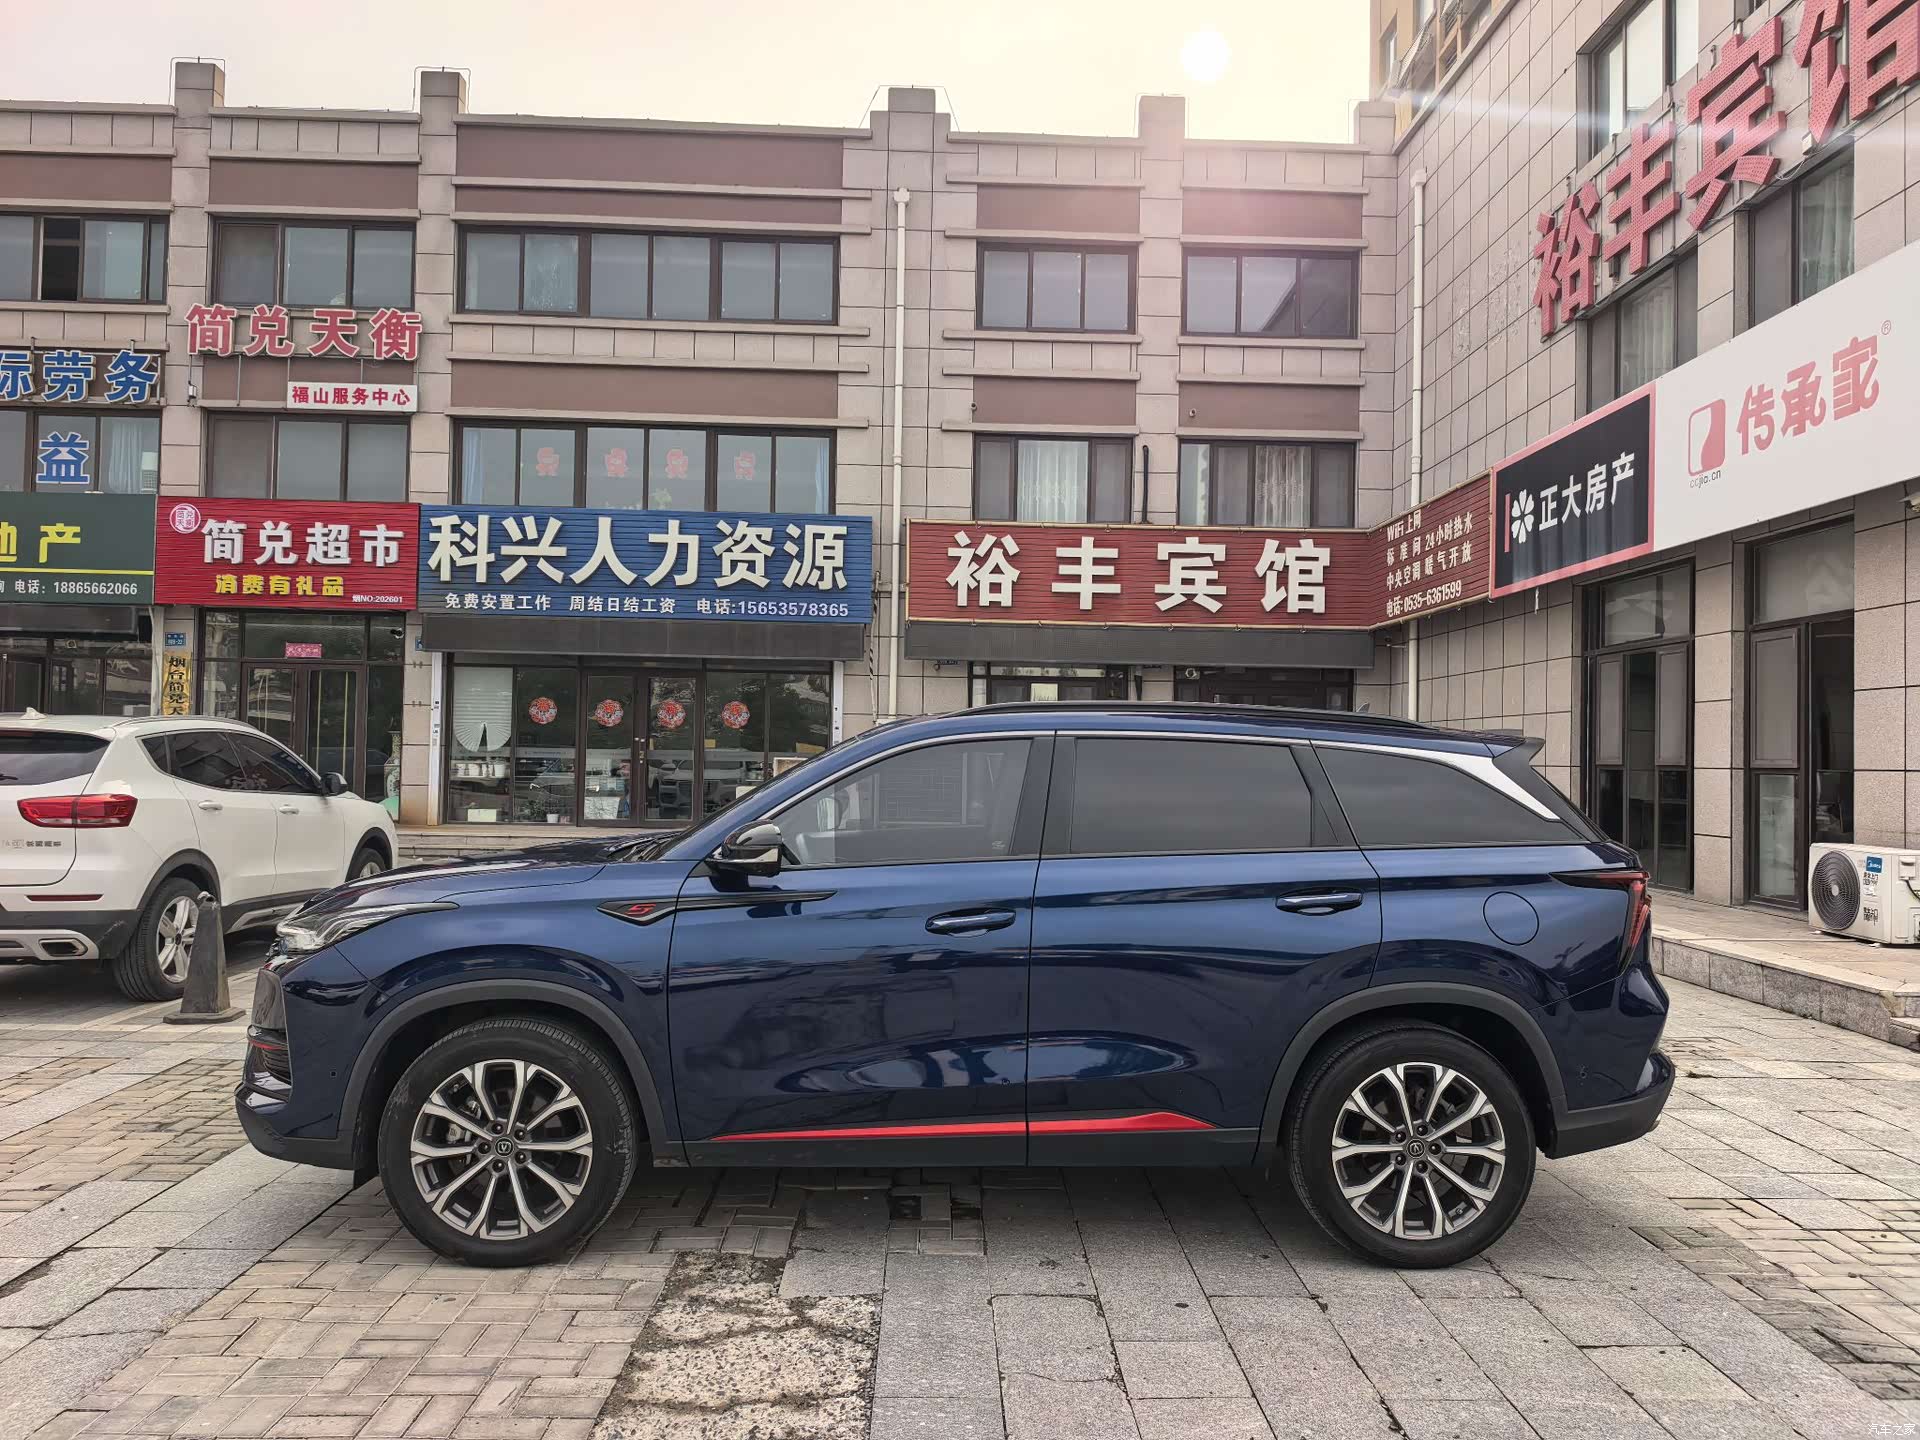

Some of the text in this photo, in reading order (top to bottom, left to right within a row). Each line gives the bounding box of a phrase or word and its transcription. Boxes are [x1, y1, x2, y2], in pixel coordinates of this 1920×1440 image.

[1534, 0, 1920, 341] 裕丰宾馆
[184, 303, 423, 361] 简兑天衡
[292, 386, 411, 406] 福山服务中心
[1736, 336, 1881, 455] 传承家
[36, 431, 90, 485] 益
[1538, 451, 1635, 531] 正大房产
[201, 519, 404, 566] 简兑超市
[427, 514, 848, 590] 科兴人力资源
[946, 530, 1331, 613] 裕丰宾馆
[215, 574, 344, 596] 消费有礼品
[445, 592, 552, 611] 免费安置工作
[569, 595, 676, 614] 周结日结工资
